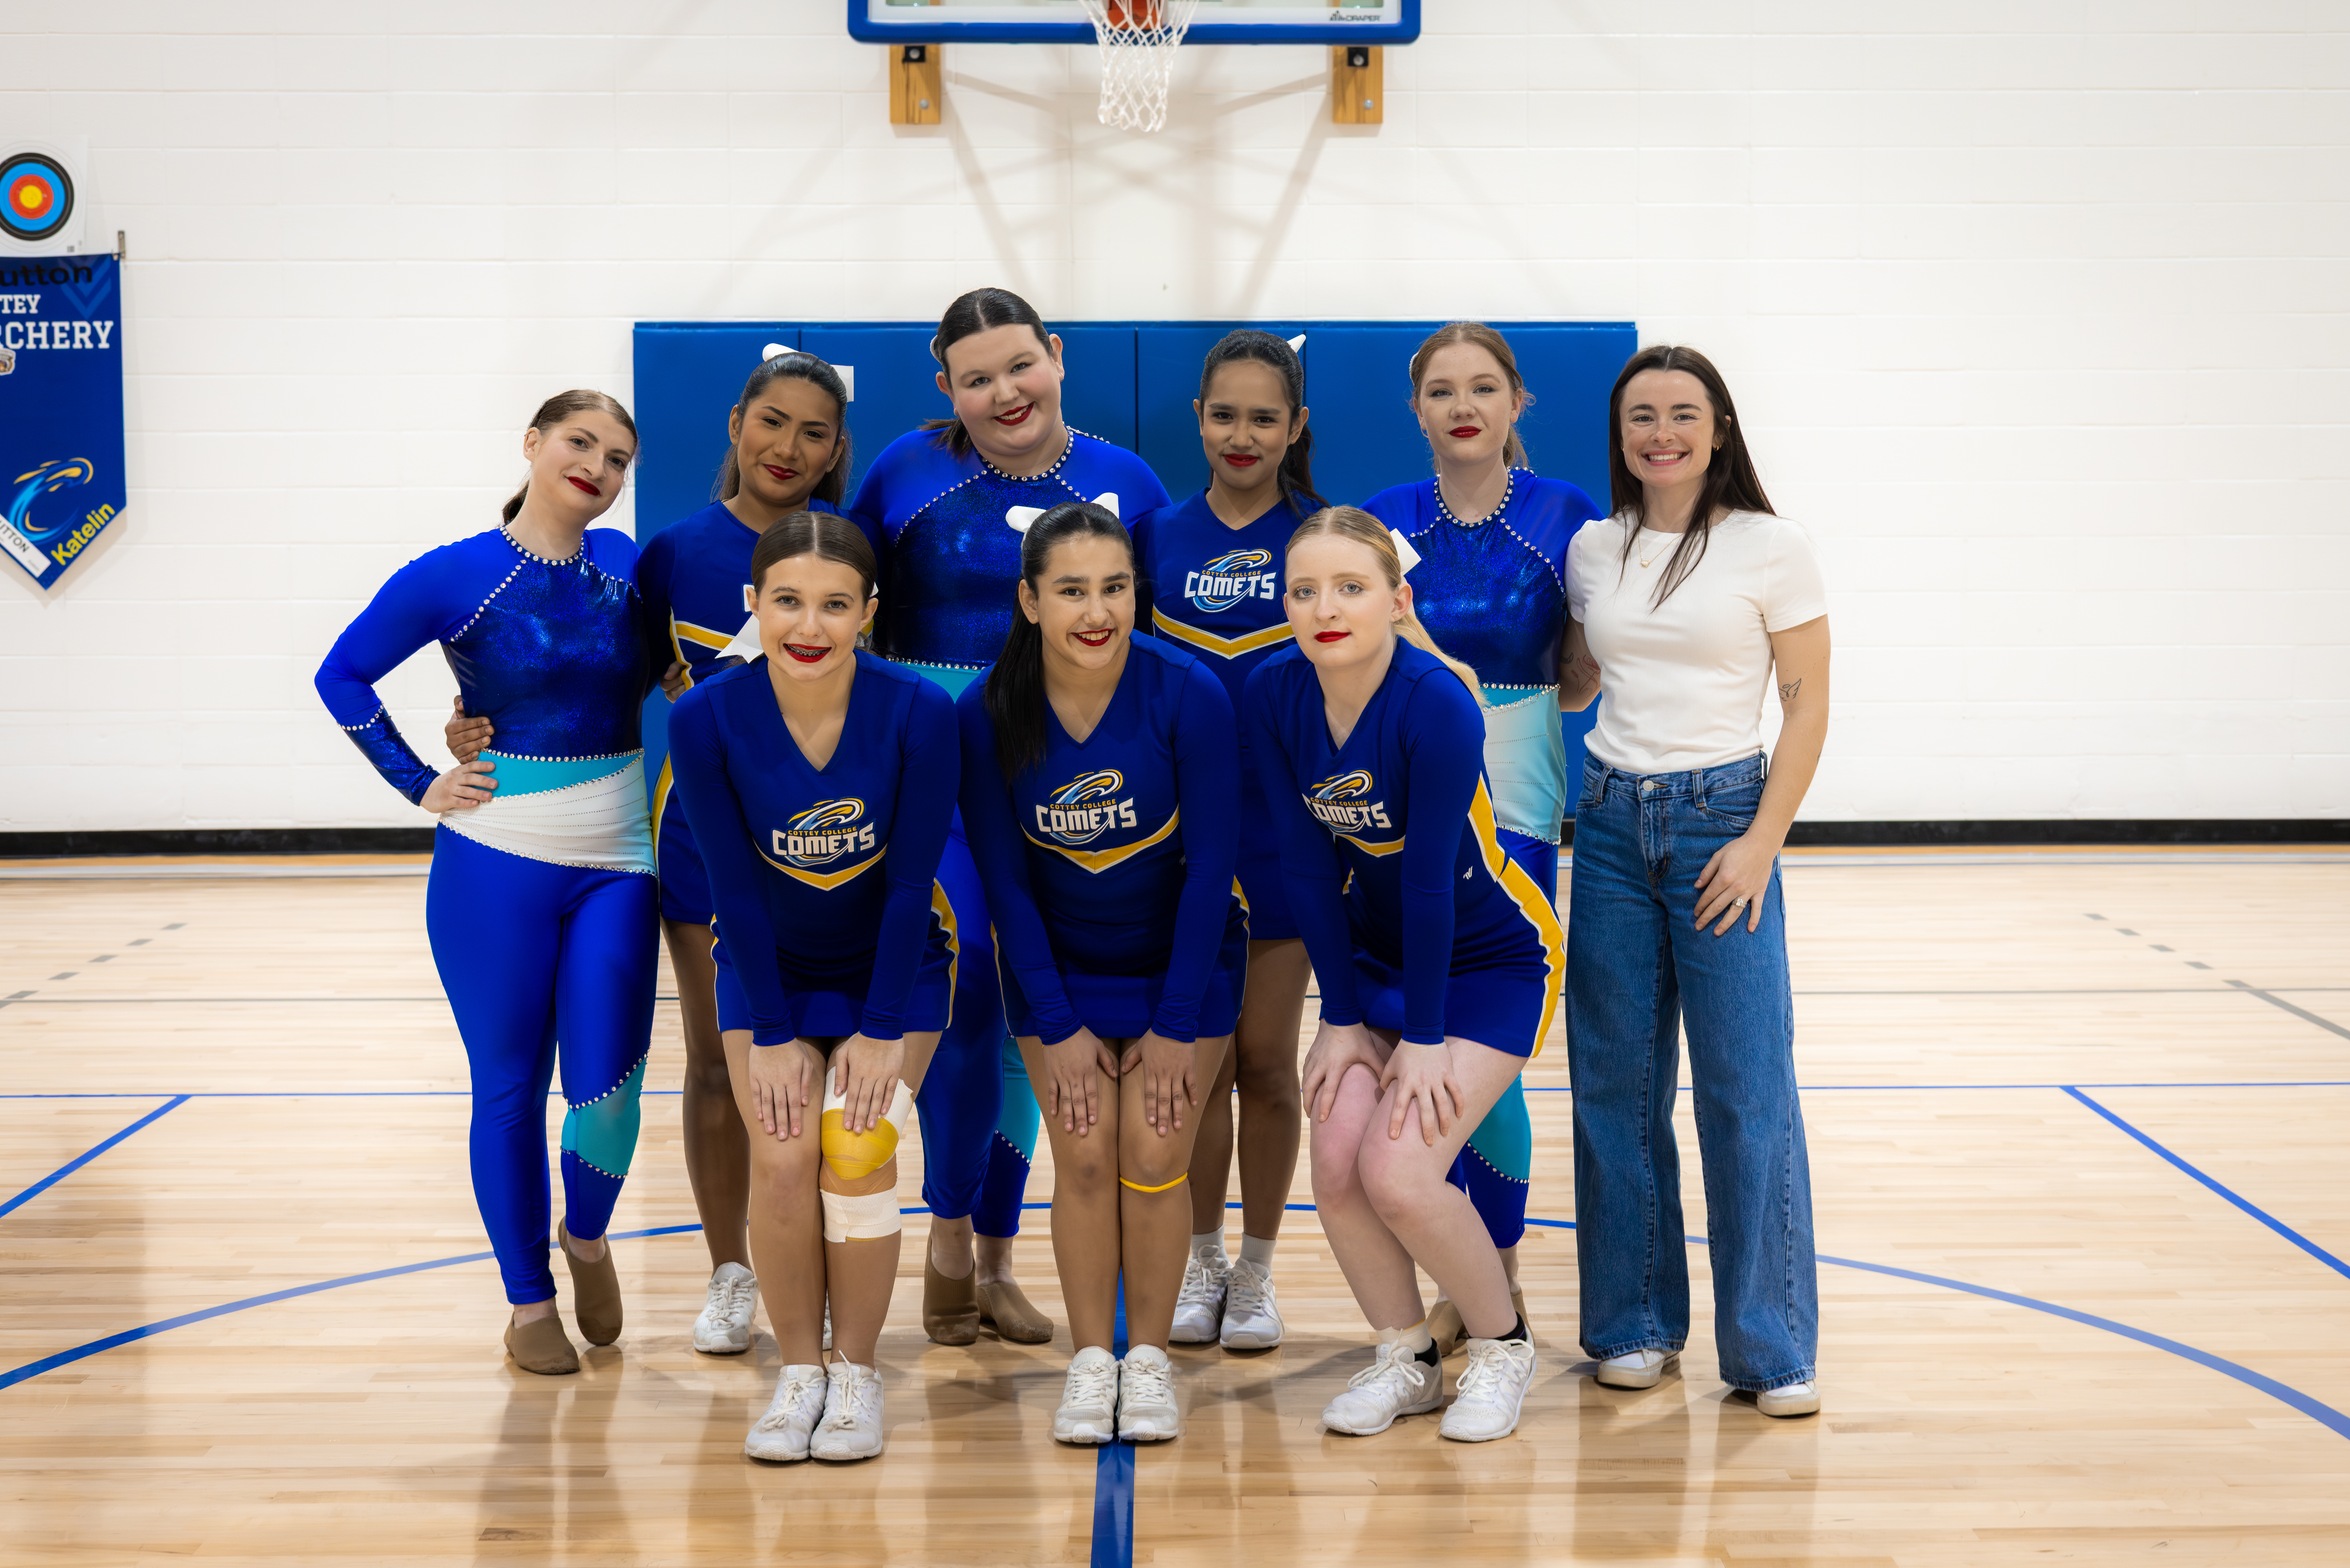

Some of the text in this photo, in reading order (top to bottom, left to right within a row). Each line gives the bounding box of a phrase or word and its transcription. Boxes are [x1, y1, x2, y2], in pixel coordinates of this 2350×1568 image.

[51, 503, 115, 566] Katelin
[1184, 571, 1276, 600] COMETS
[1201, 569, 1229, 577] COTTEY
[1035, 797, 1137, 832] COMETS
[1083, 799, 1117, 809] COLLEGE
[772, 822, 875, 856] COMETS
[821, 826, 857, 836] COLLEGE
